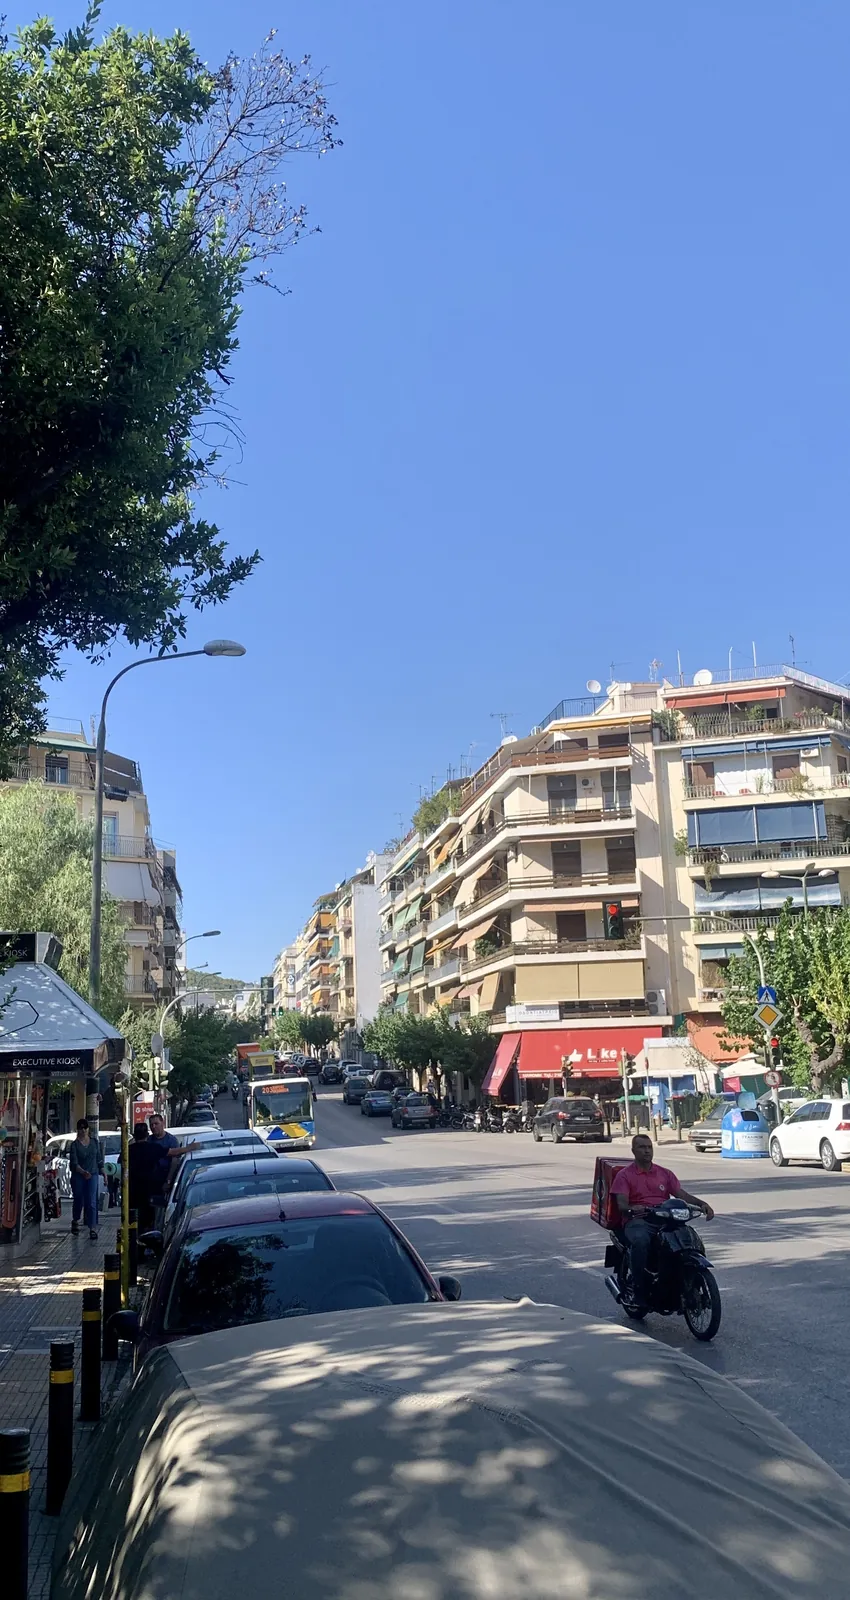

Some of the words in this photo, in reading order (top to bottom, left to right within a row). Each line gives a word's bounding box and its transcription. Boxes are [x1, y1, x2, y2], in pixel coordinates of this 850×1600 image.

[4, 949, 28, 957] KIOSK
[587, 1048, 617, 1059] Like
[12, 1058, 56, 1066] EXECUTIVE
[56, 1057, 81, 1065] KIOSK
[262, 1086, 273, 1094] 203
